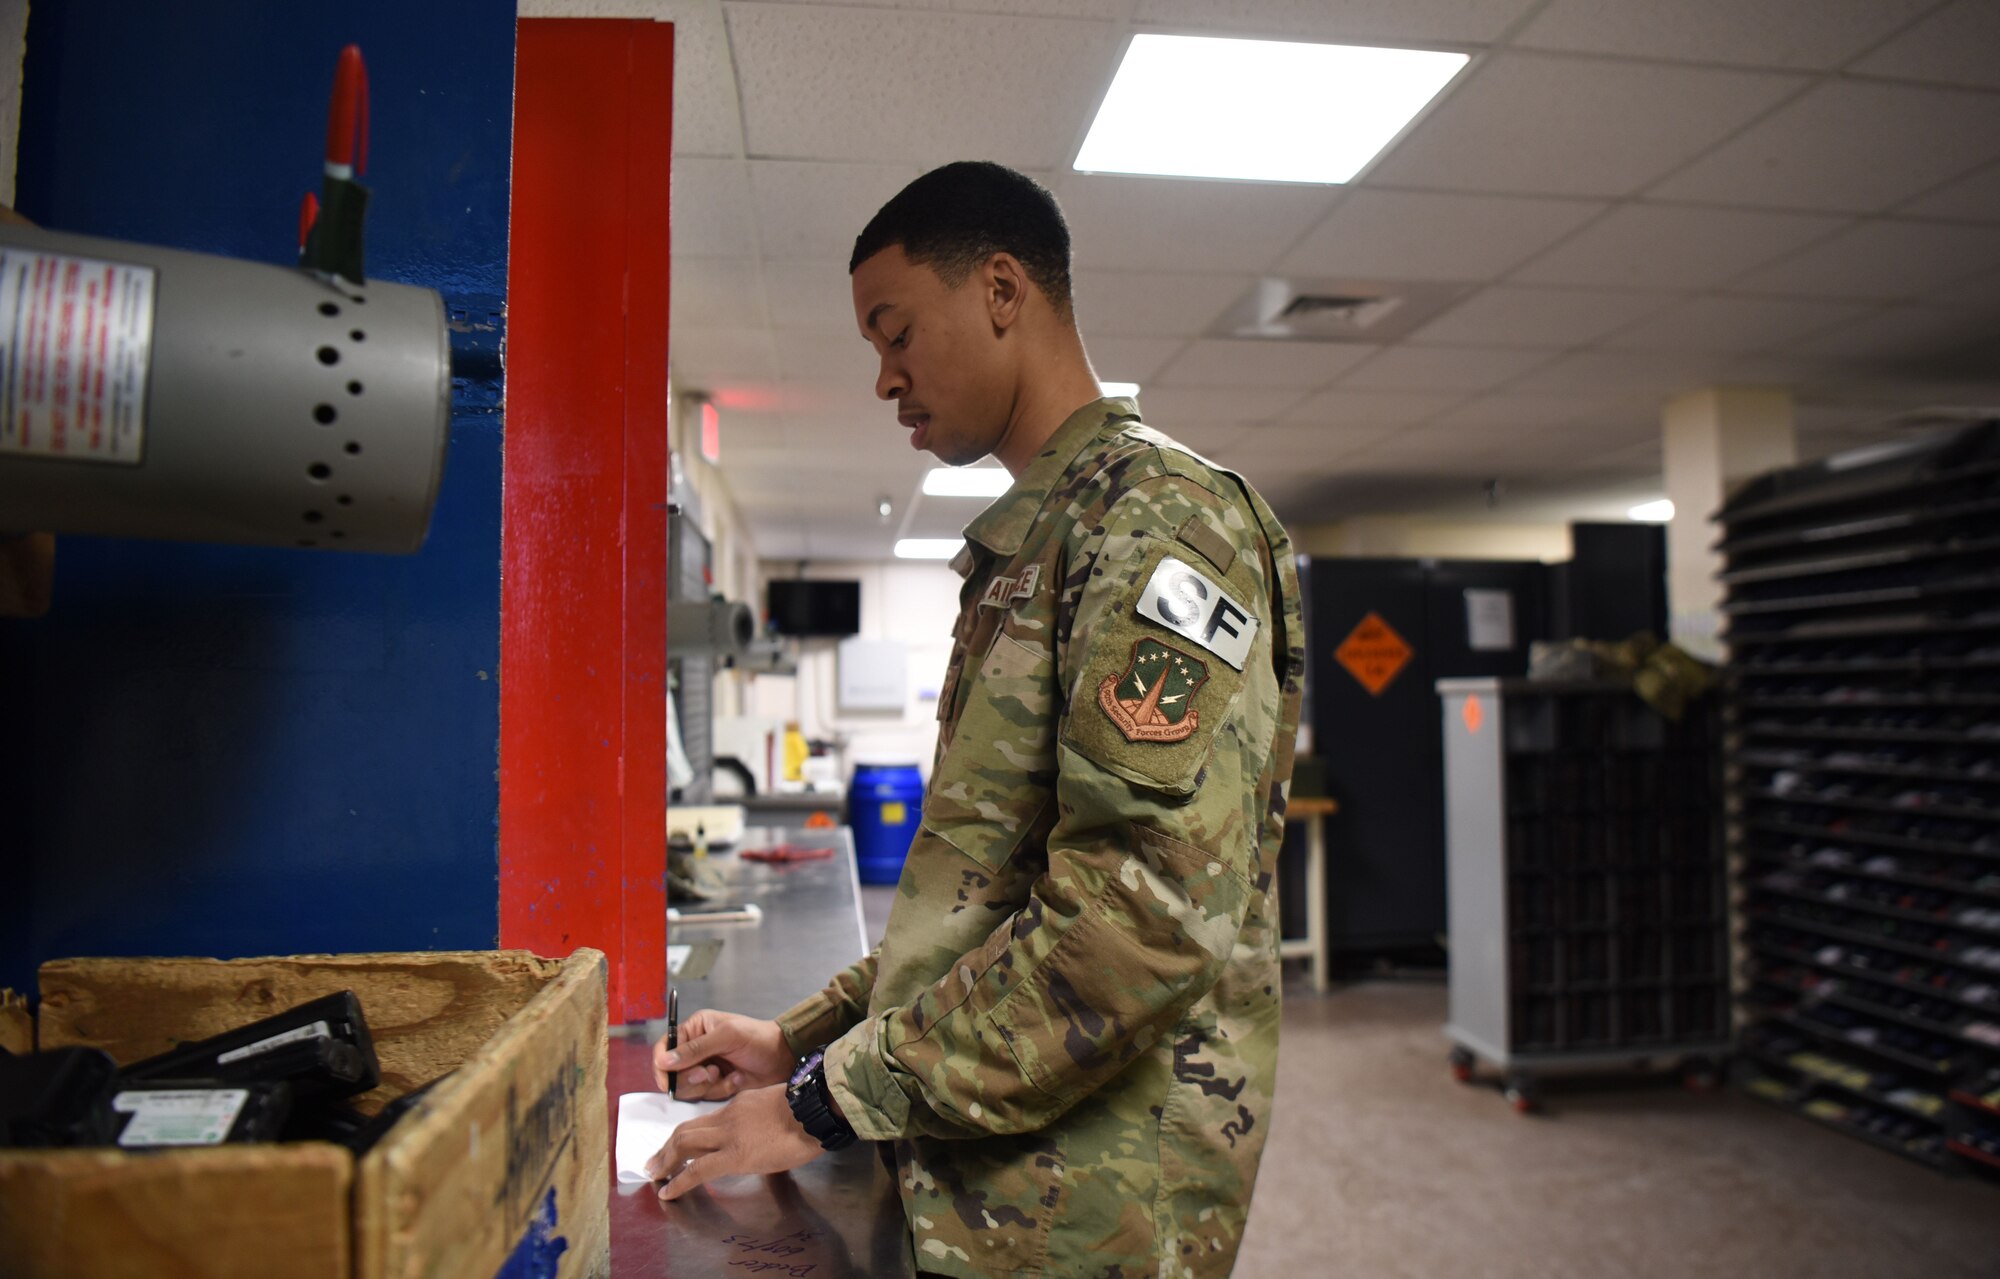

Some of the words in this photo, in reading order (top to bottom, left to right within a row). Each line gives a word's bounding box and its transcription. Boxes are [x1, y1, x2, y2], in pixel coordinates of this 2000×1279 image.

[1156, 571, 1247, 643] SF
[1110, 705, 1133, 731] Security
[1136, 728, 1162, 737] Forces
[1164, 725, 1191, 737] Group
